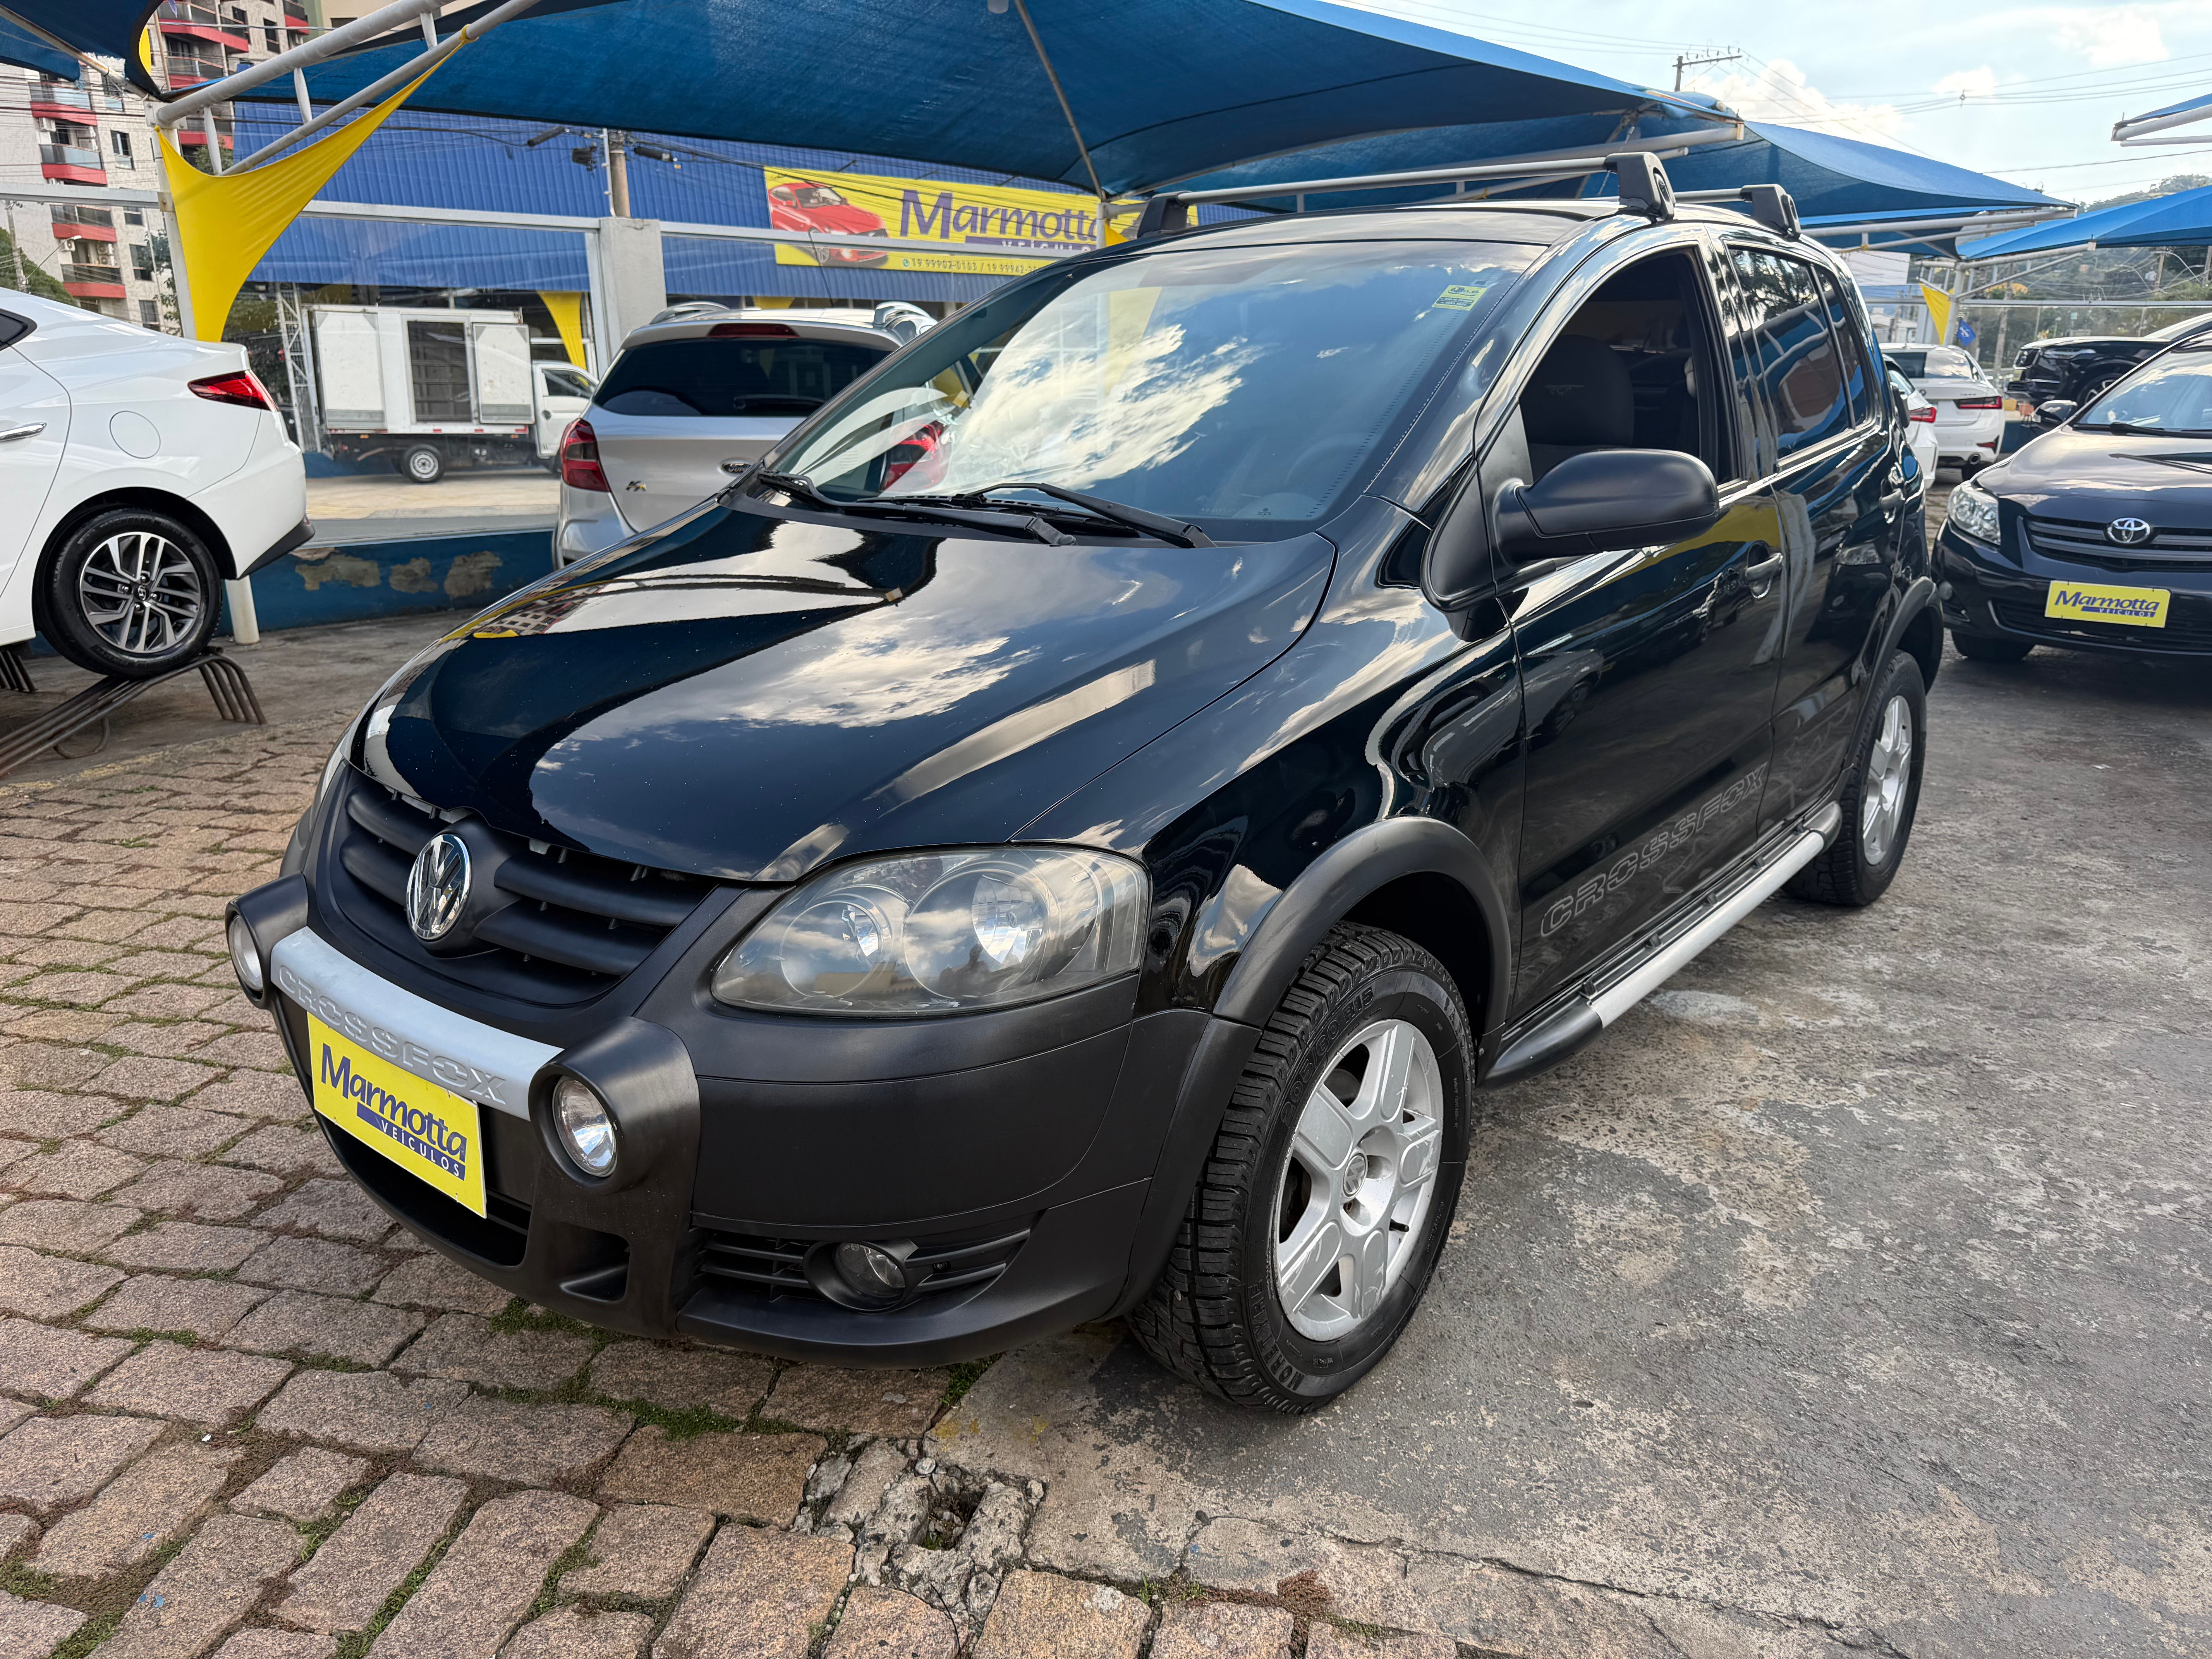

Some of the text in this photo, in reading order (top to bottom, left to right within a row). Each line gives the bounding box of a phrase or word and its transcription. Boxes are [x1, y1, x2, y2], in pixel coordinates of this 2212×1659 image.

[2054, 591, 2160, 611] Marmotta
[1540, 762, 1768, 937] CROSSFOX
[279, 964, 507, 1105] CROSSFOX
[321, 1042, 467, 1163] Marmotta
[381, 1119, 460, 1177] VEÍCULOS
